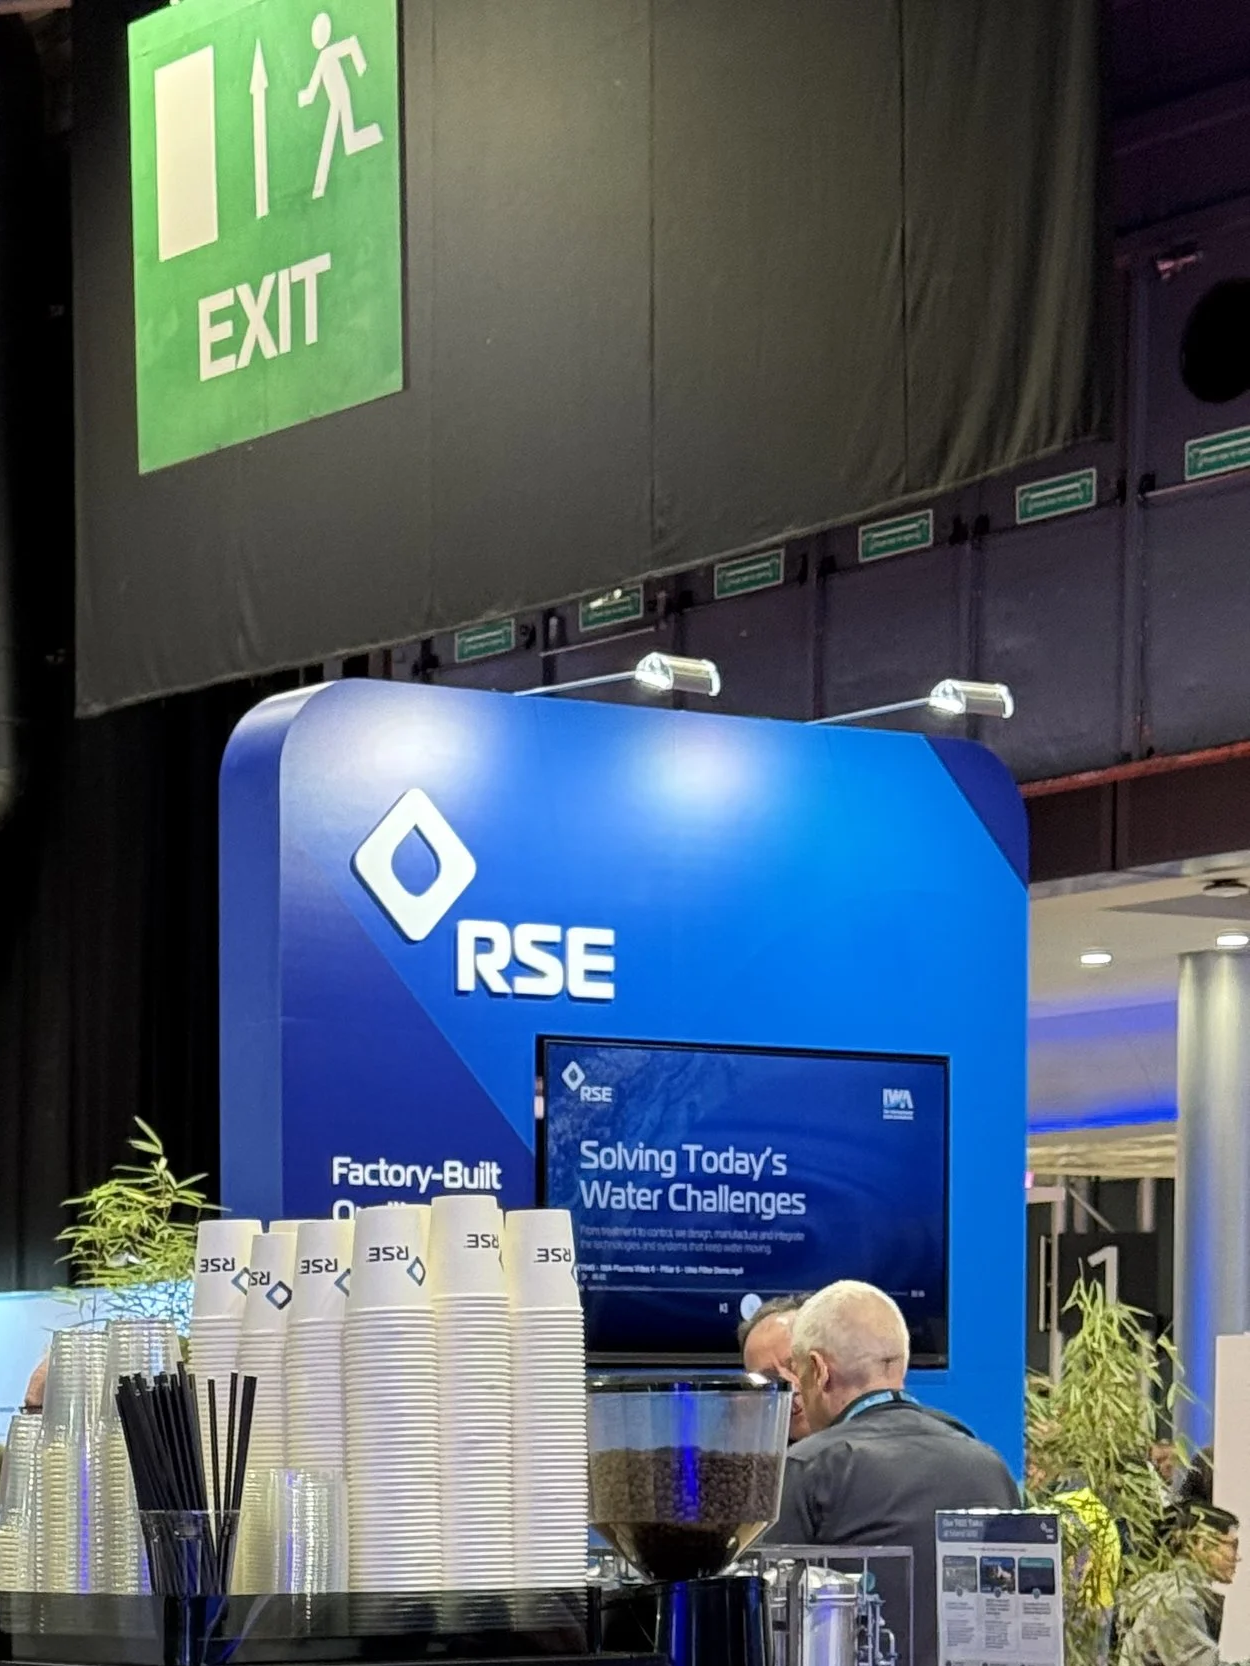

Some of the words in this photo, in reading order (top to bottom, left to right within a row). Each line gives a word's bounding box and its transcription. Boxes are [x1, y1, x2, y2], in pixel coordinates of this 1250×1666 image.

[197, 253, 331, 382] EXIT
[456, 919, 616, 1000] RSE
[579, 1086, 613, 1102] RSE
[580, 1139, 677, 1179] Solving
[681, 1143, 788, 1182] Today's
[332, 1157, 503, 1194] Factory-Built
[579, 1179, 663, 1211] Water
[668, 1183, 807, 1220] Challenges
[463, 1234, 500, 1249] RSE
[366, 1246, 410, 1263] RSE
[534, 1248, 572, 1263] RSE
[200, 1257, 236, 1273] RSE
[299, 1258, 339, 1275] RSE
[249, 1271, 270, 1287] RS
[1087, 1246, 1119, 1308] 1
